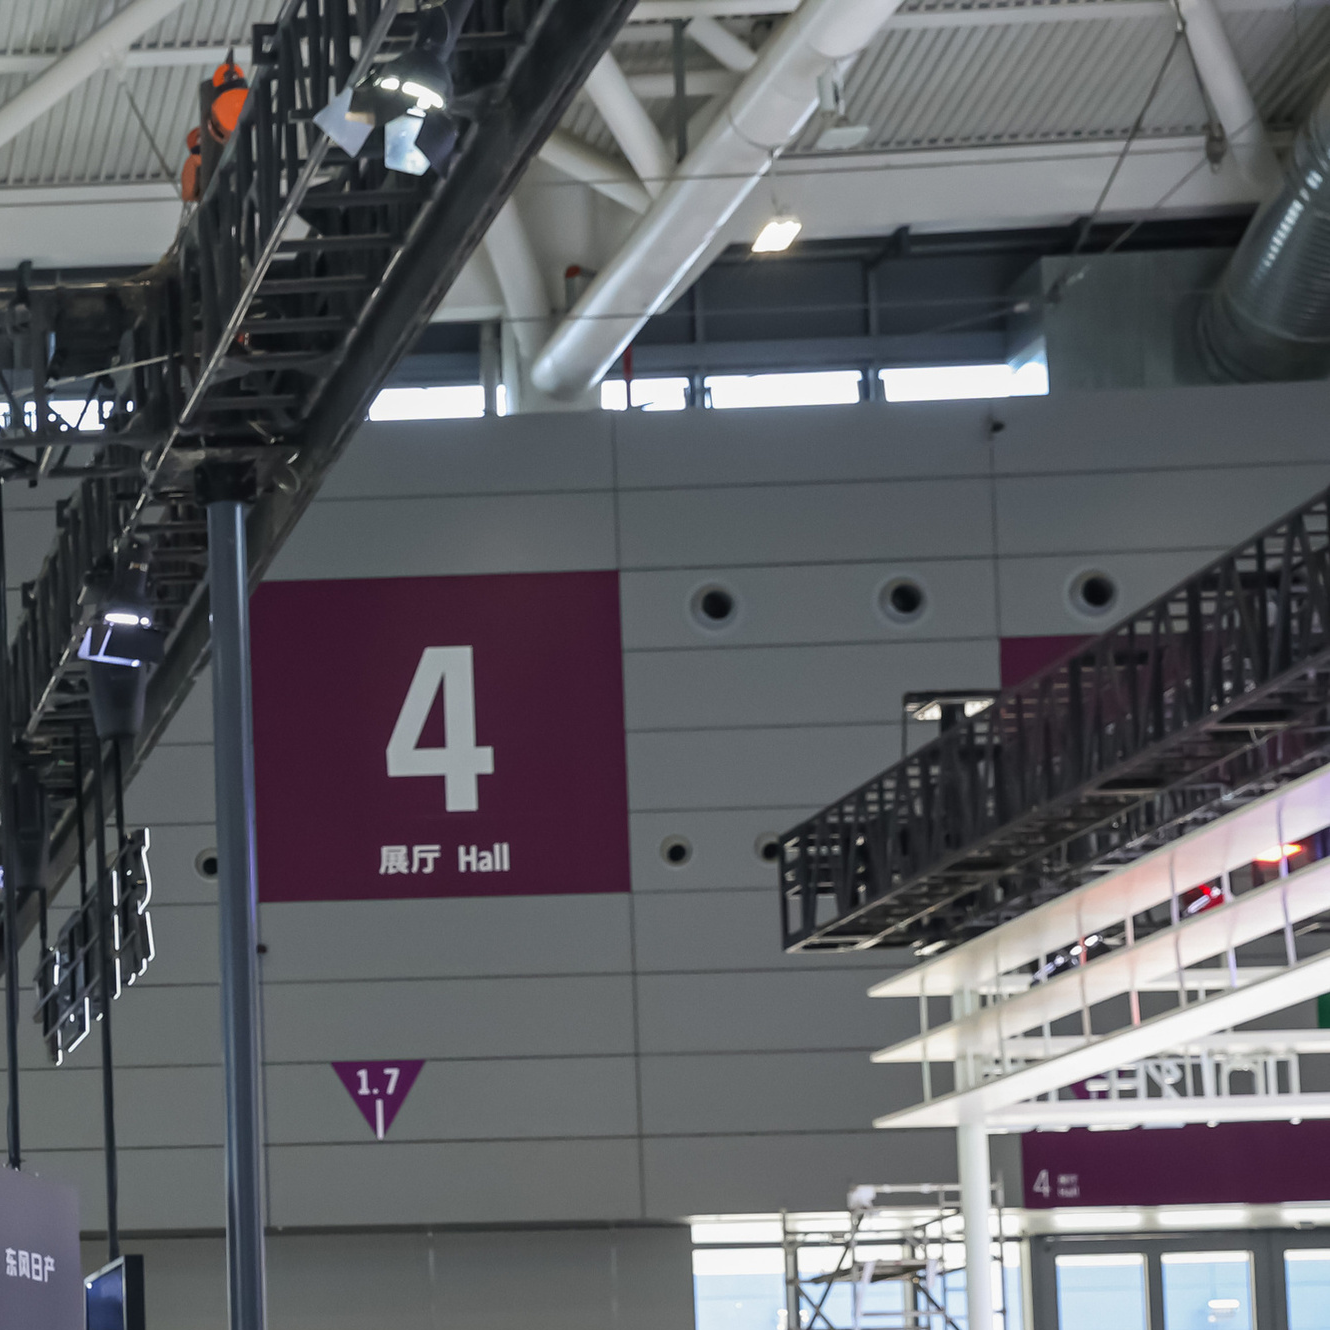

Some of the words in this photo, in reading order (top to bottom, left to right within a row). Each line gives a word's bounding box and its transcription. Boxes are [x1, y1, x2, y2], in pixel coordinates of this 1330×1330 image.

[385, 645, 495, 812] 4
[379, 844, 441, 875] 展厅
[457, 841, 511, 873] Hall
[356, 1067, 401, 1096] 1.7
[1032, 1168, 1051, 1199] 4
[4, 1247, 56, 1284] 东风日产
